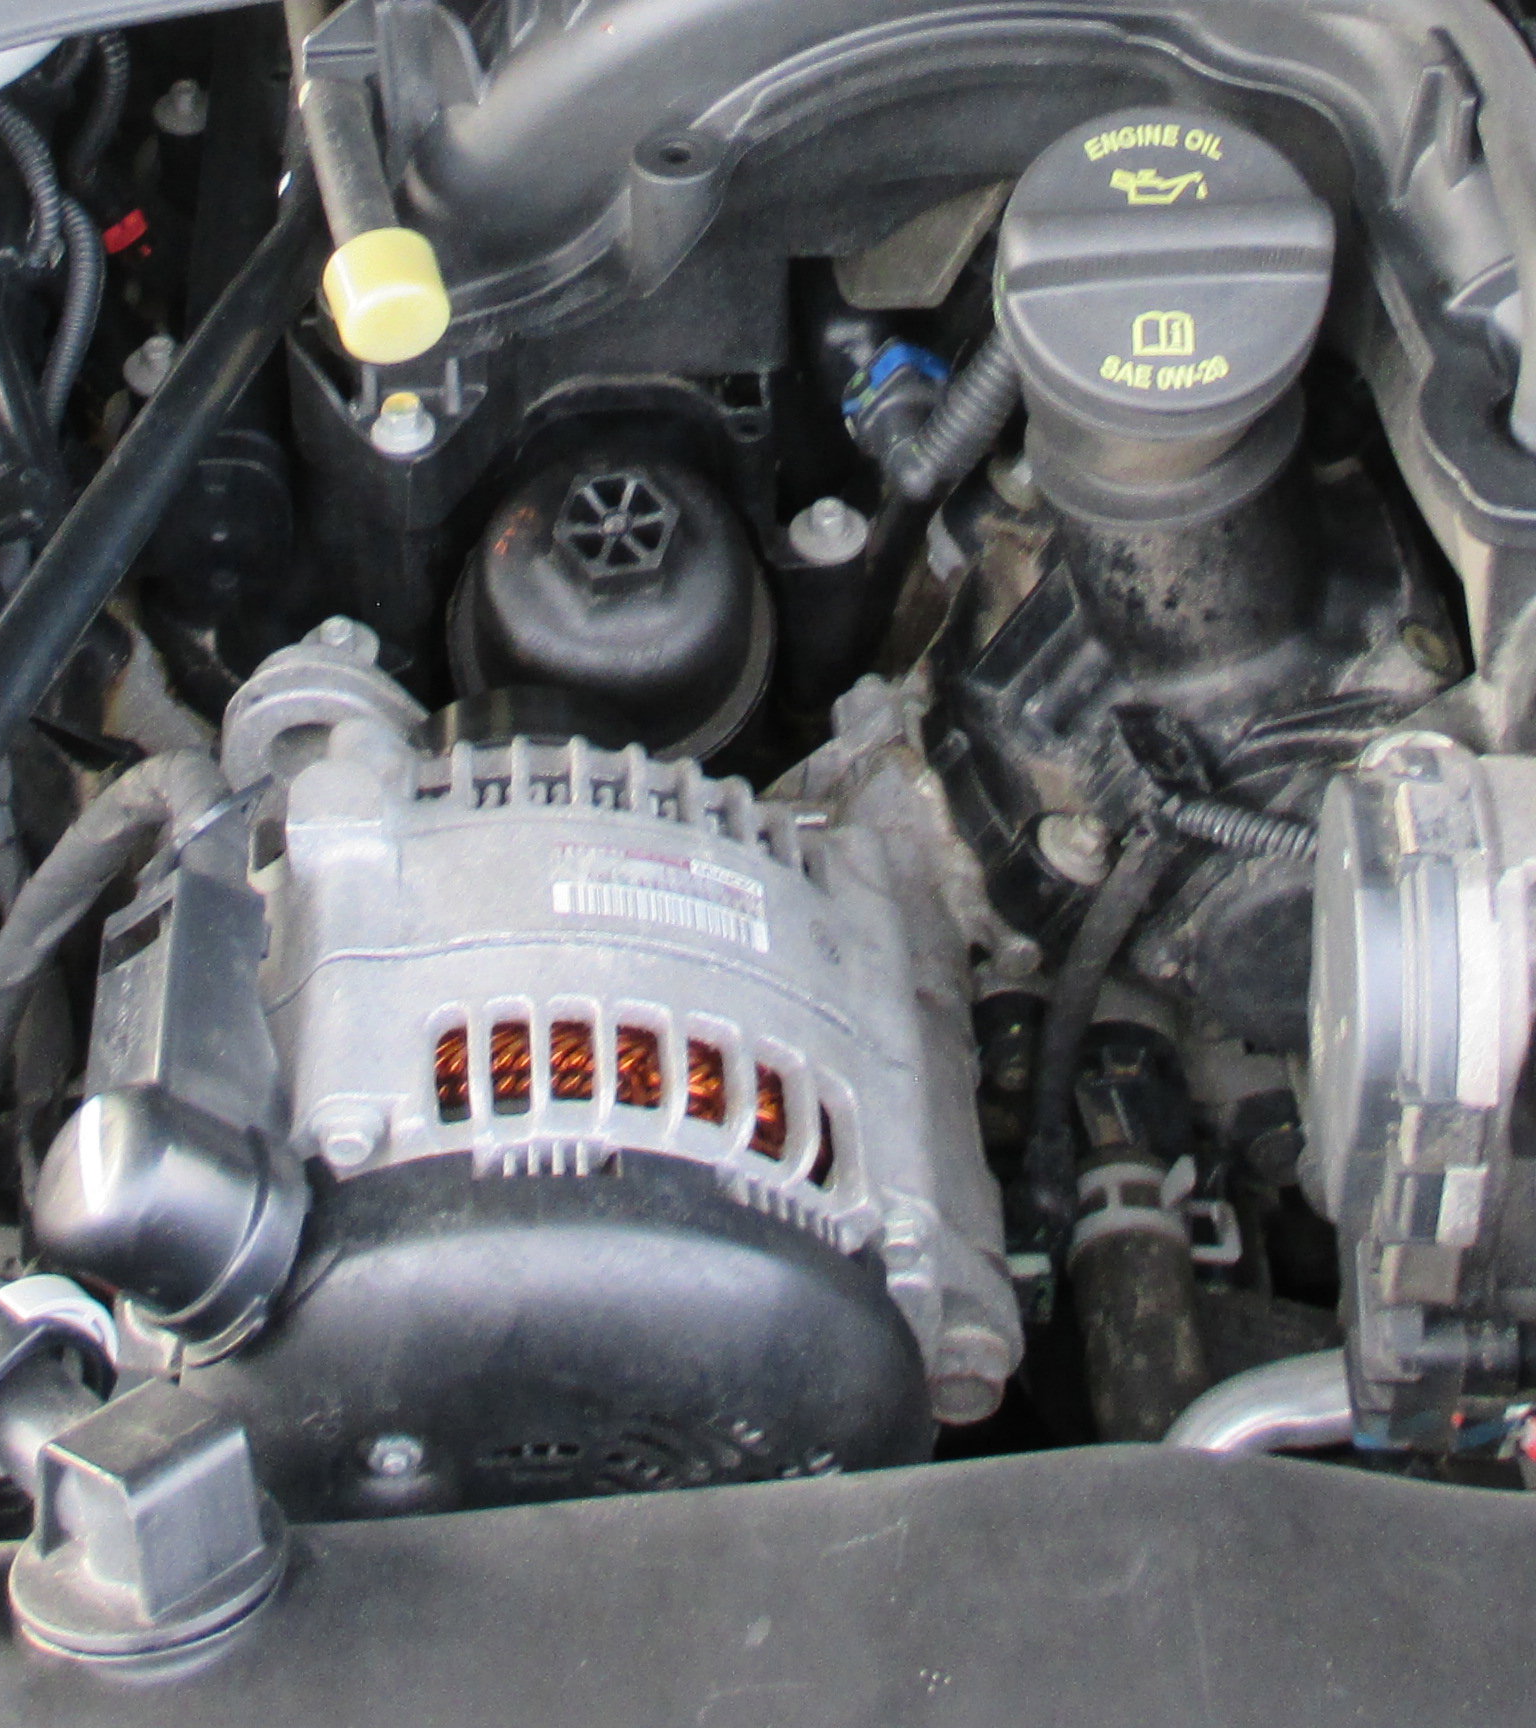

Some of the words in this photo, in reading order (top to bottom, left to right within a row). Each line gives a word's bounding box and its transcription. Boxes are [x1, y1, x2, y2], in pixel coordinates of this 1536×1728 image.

[1083, 124, 1181, 162] ENGINE
[1184, 128, 1223, 162] OIL
[1099, 354, 1154, 389] SAE
